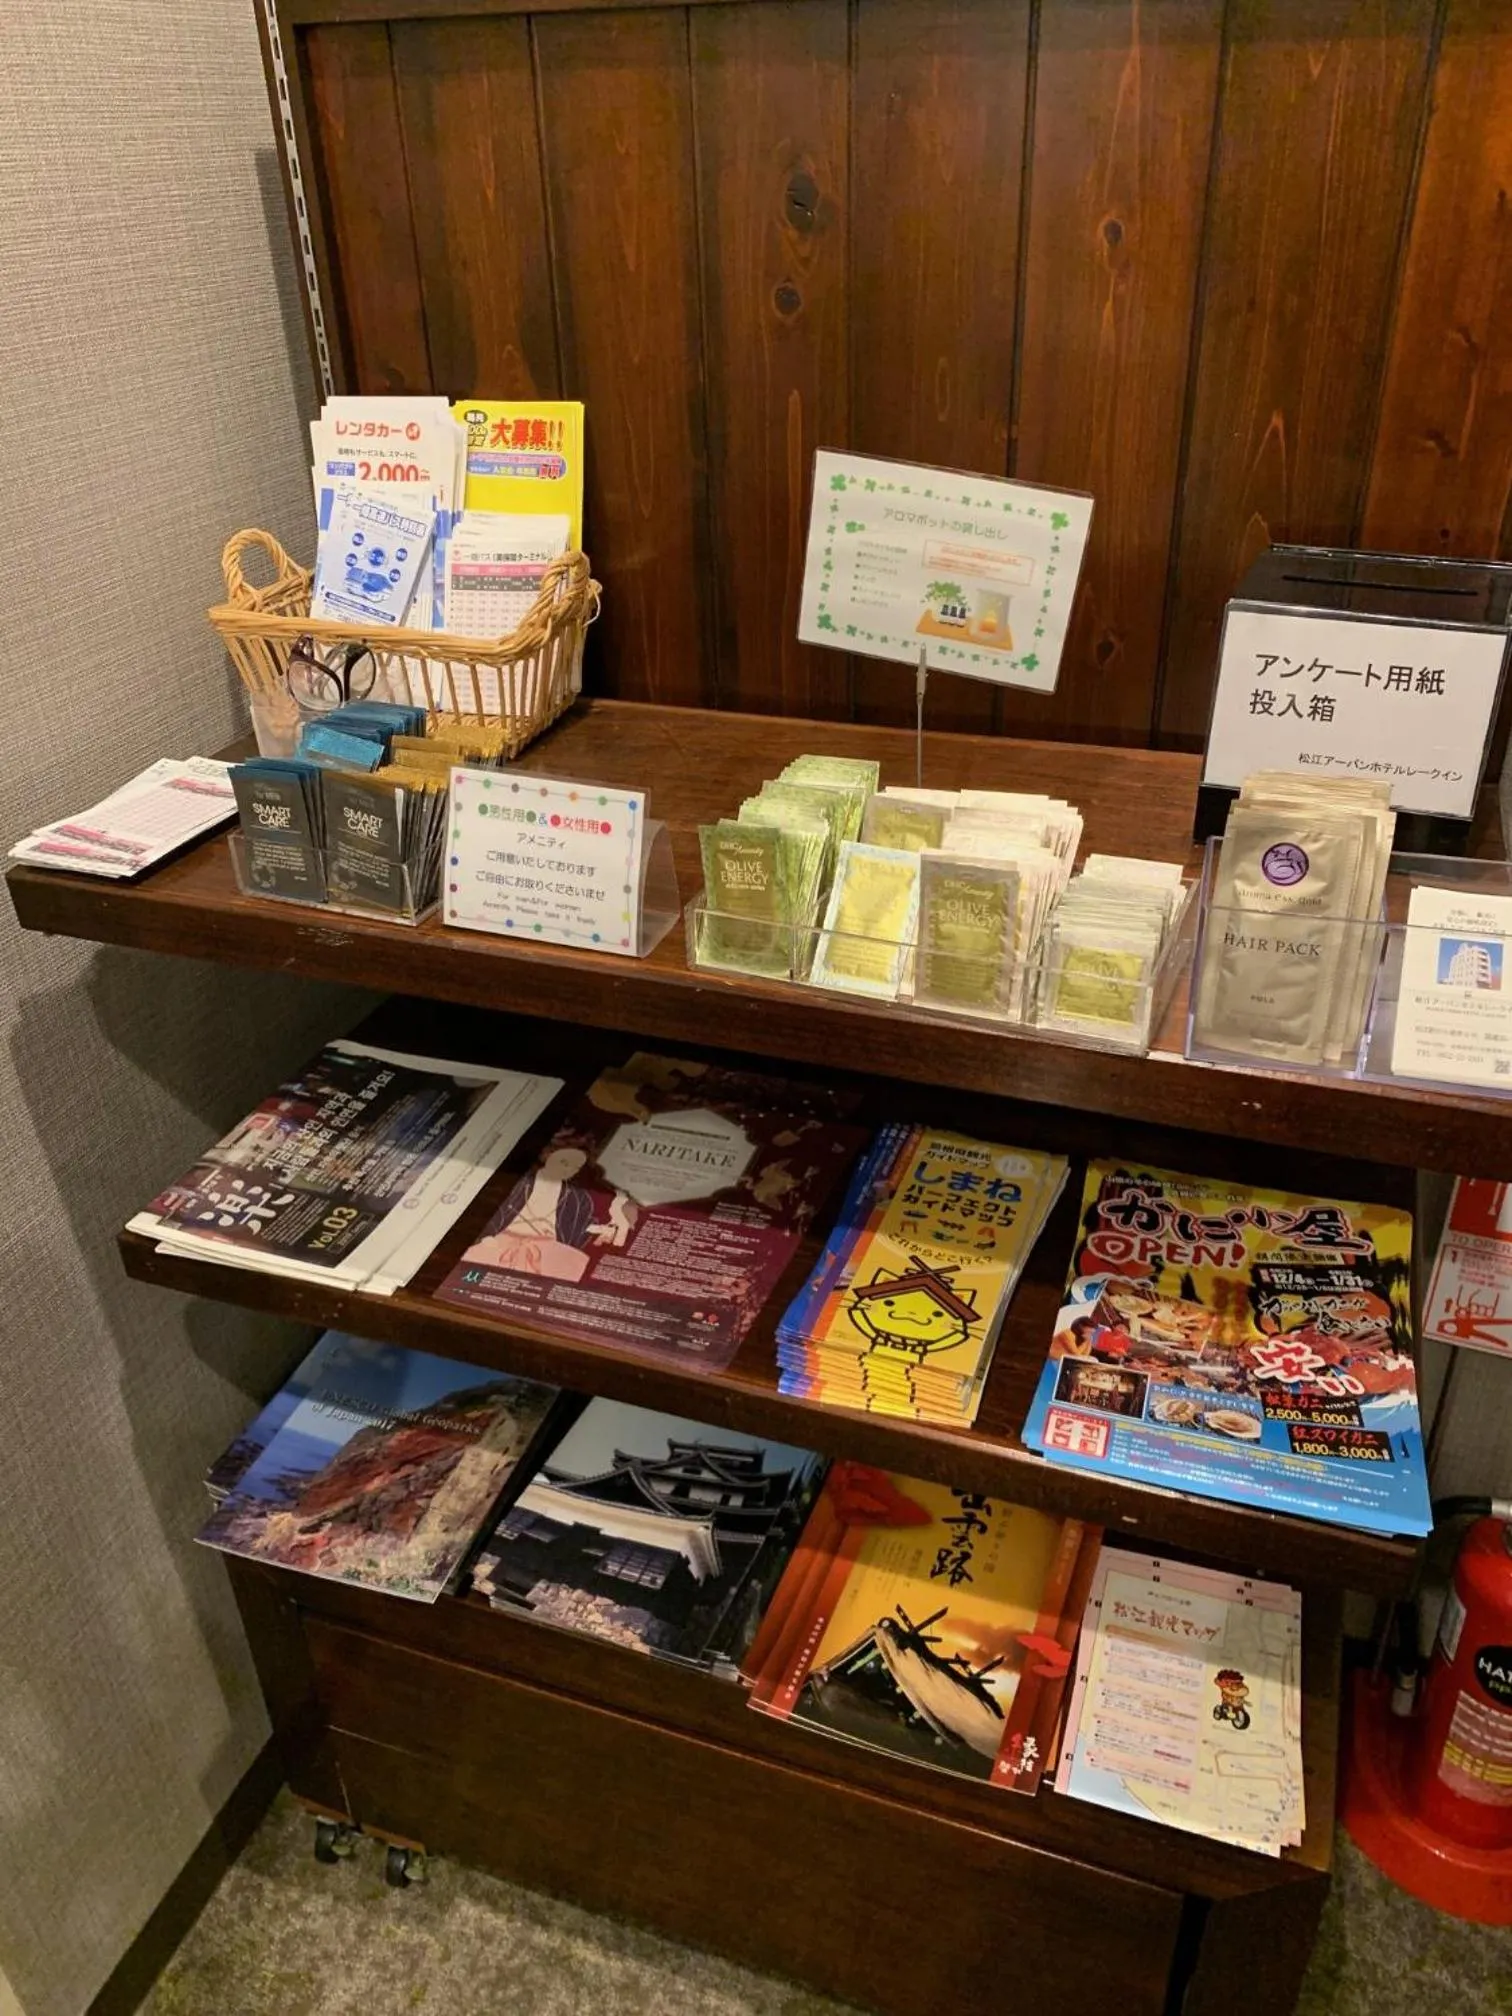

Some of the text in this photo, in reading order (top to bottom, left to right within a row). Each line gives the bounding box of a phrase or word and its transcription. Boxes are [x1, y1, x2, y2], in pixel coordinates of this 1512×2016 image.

[336, 421, 402, 437] レンタカー
[883, 507, 1008, 540] アロマポットの貸し出し
[1255, 653, 1446, 696] アンケート用紙
[1249, 688, 1336, 722] 投入箱
[1298, 752, 1463, 782] 松江アーバンホテルレークイン
[252, 802, 291, 818] SMART
[258, 812, 290, 828] CARE
[343, 806, 383, 828] SMART
[489, 805, 526, 823] 男性用
[562, 817, 600, 835] 女性用
[347, 817, 379, 838] CARE
[516, 832, 566, 850] アメニティ
[486, 850, 597, 877] ご用意いたしております
[725, 860, 763, 873] OLIVE
[475, 870, 605, 901] ご自由にお取りくださいませ
[720, 870, 769, 885] ENERGY
[938, 907, 999, 928] ENERGY
[946, 898, 990, 916] OLIVE
[1223, 932, 1322, 957] HAIR PACK
[621, 1136, 737, 1170] NARITAKE
[913, 1161, 1022, 1202] しまね
[902, 1193, 1015, 1228] ガイドマップ
[906, 1184, 1017, 1216] パーフェクト
[1099, 1188, 1375, 1255] かに小屋
[1086, 1230, 1246, 1268] OPEN!
[310, 1402, 325, 1414] of
[325, 1404, 363, 1423] Japan
[422, 1414, 481, 1434] Geoparks
[1112, 1600, 1222, 1641] 松江観光マップ
